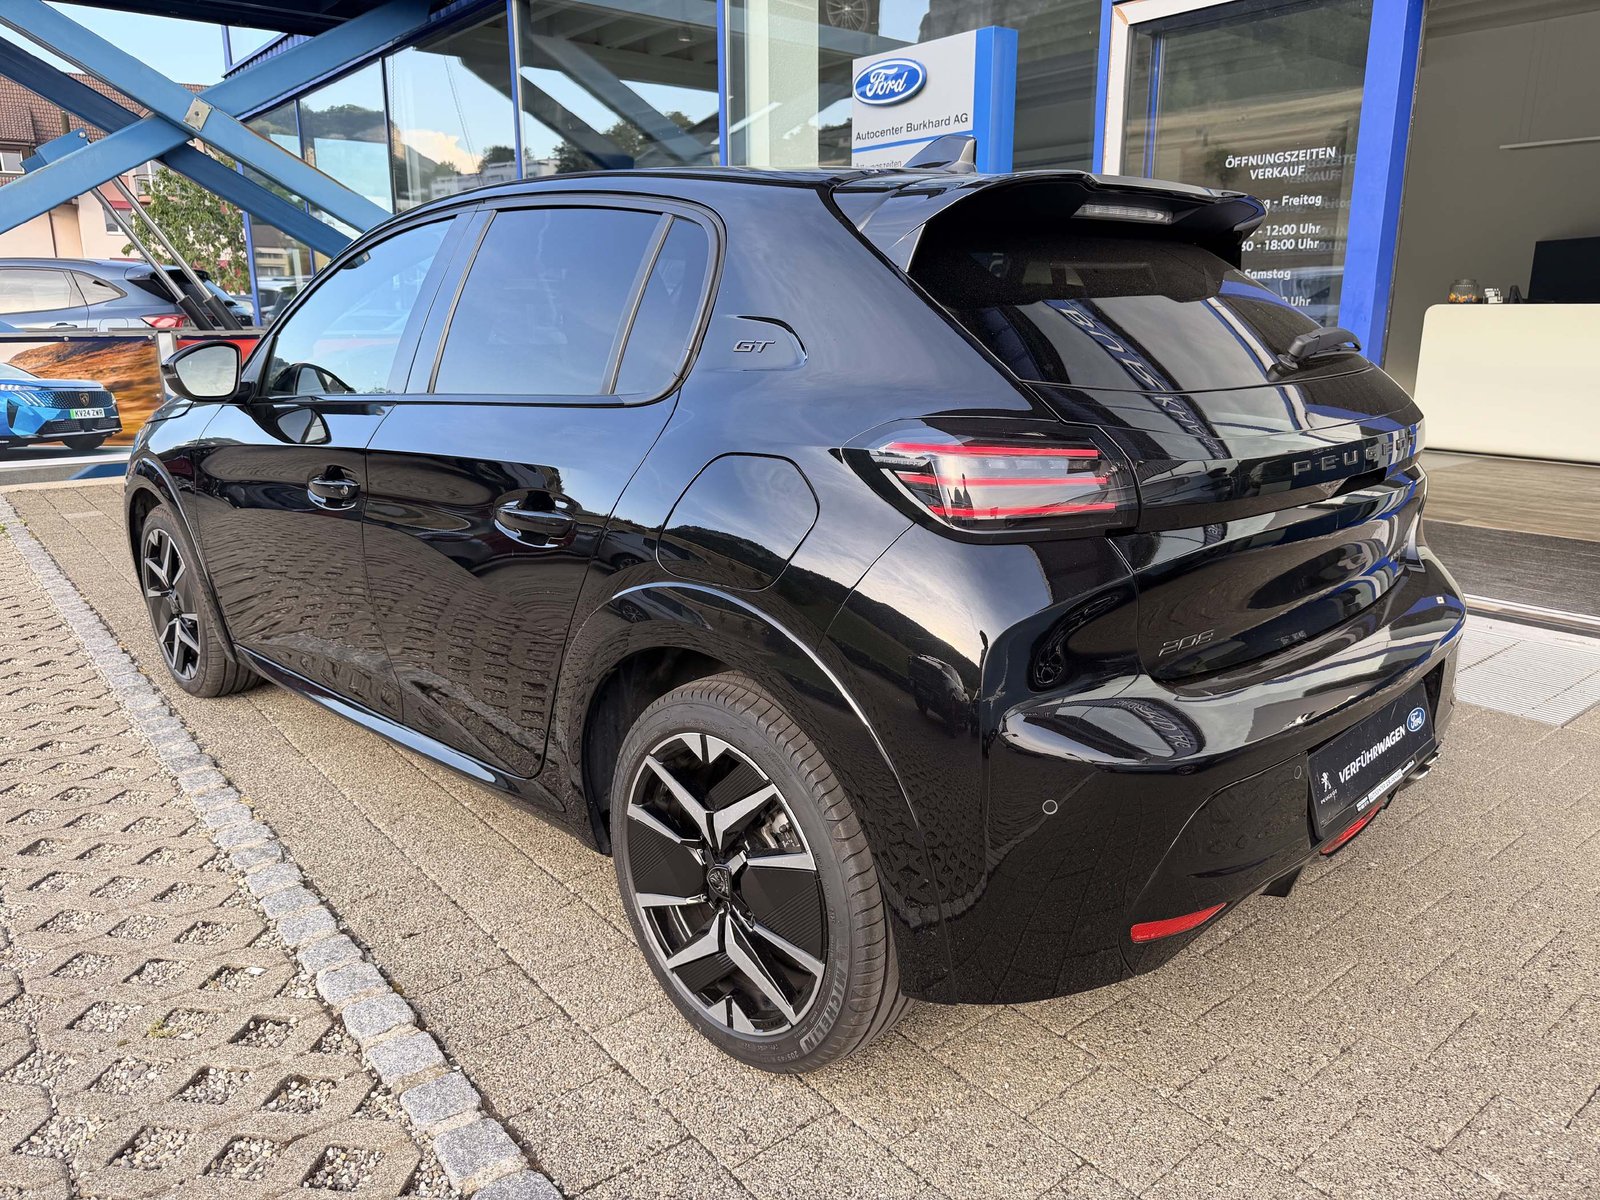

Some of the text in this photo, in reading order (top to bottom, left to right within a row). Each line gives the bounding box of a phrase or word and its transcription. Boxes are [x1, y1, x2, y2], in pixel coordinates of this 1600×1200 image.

[866, 66, 908, 97] Ford
[855, 112, 969, 141] Autocenter Burkhard AG
[1225, 146, 1336, 168] ÖFFNUNGSZEITEN
[1250, 165, 1306, 180] VERKAUF
[1282, 195, 1322, 206] Freitag
[1266, 224, 1297, 236] 12:00
[1299, 223, 1321, 234] Uhr
[1264, 239, 1295, 251] 18:00
[1297, 238, 1320, 249] Uhr
[1244, 268, 1291, 281] Samstag
[1290, 296, 1312, 307] Uhr
[733, 340, 776, 353] GT
[75, 409, 90, 417] KV24
[1338, 724, 1406, 784] VERFÜHRWAGEN
[803, 966, 848, 1052] MICHELIN
